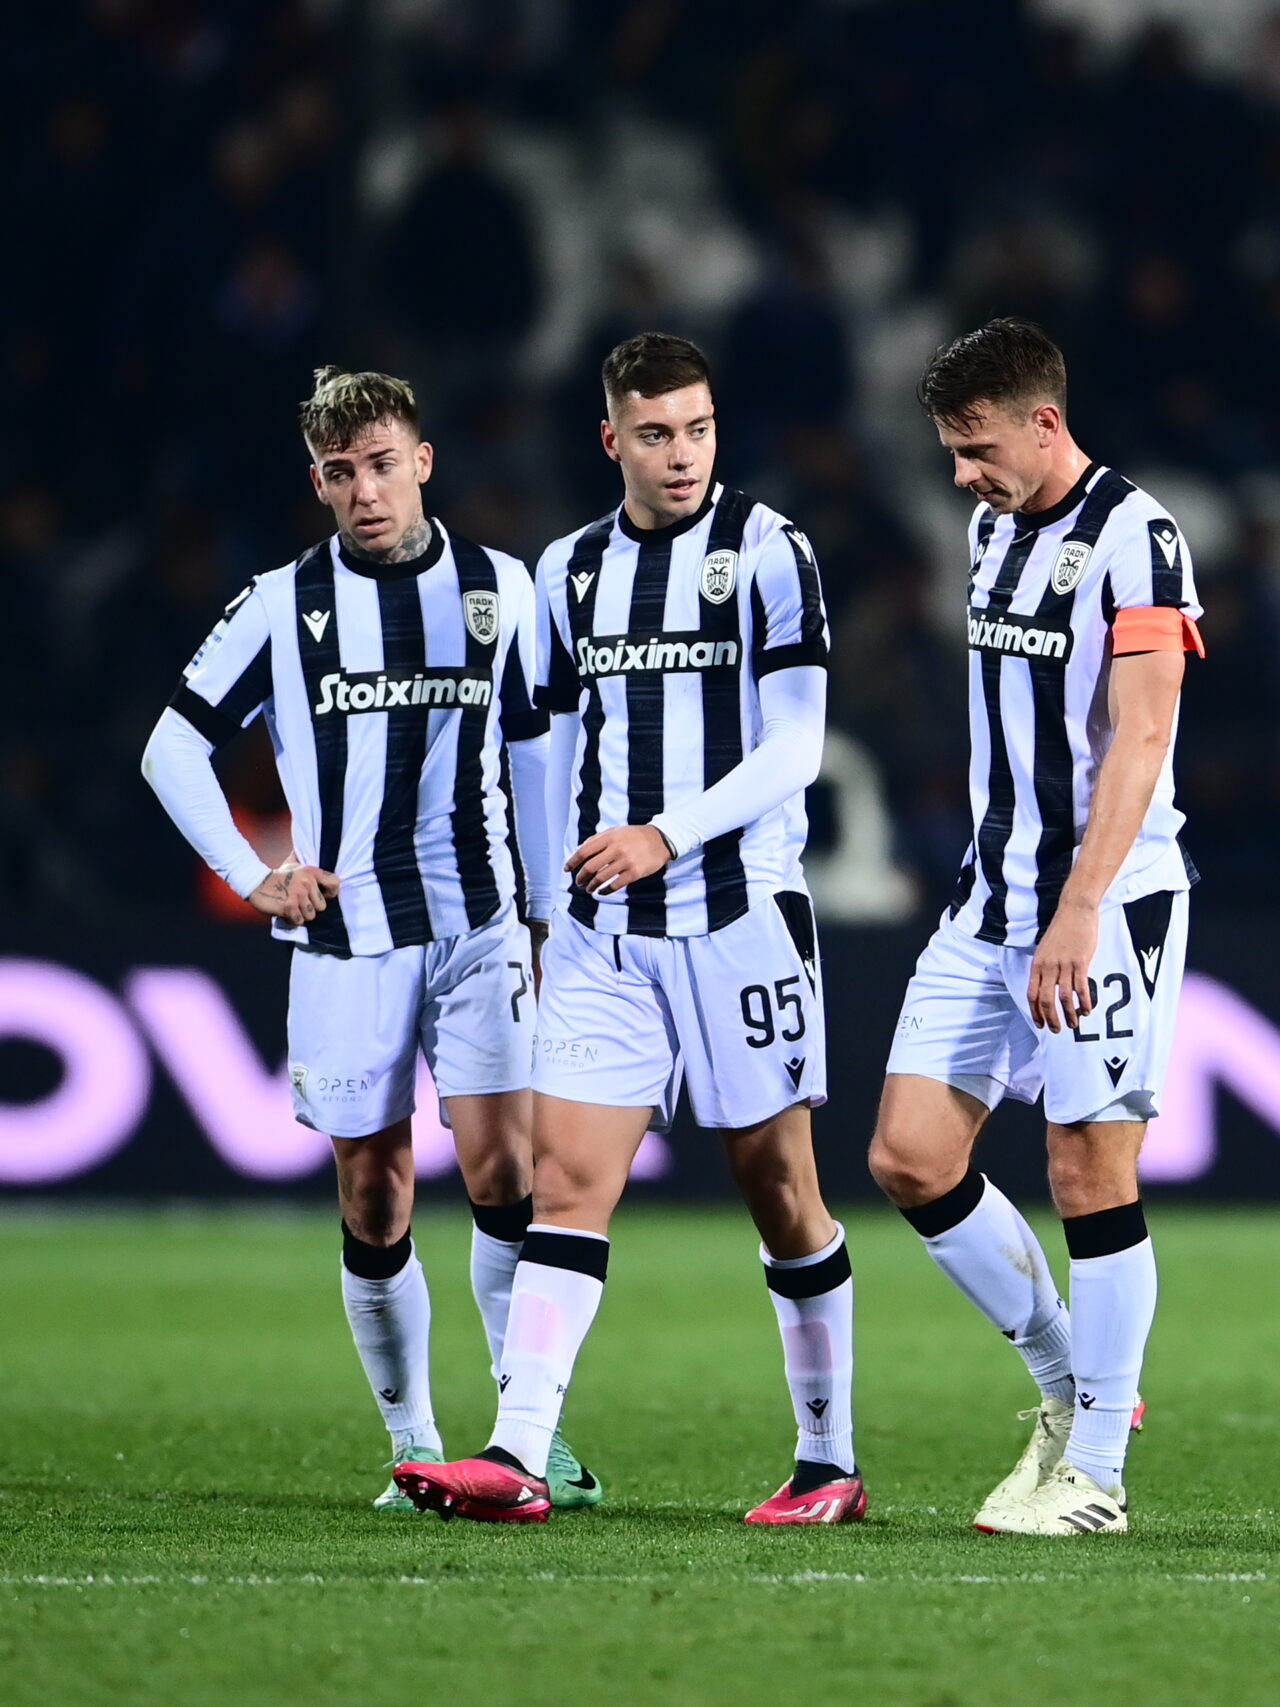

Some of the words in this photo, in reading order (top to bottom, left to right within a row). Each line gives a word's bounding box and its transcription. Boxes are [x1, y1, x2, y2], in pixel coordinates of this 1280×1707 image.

[966, 604, 1068, 659] oiximan
[576, 636, 738, 676] Stoiximan
[315, 672, 492, 715] Stoiximan
[740, 974, 806, 1049] 95
[543, 1039, 598, 1062] OPEN
[318, 1077, 370, 1093] OPEN
